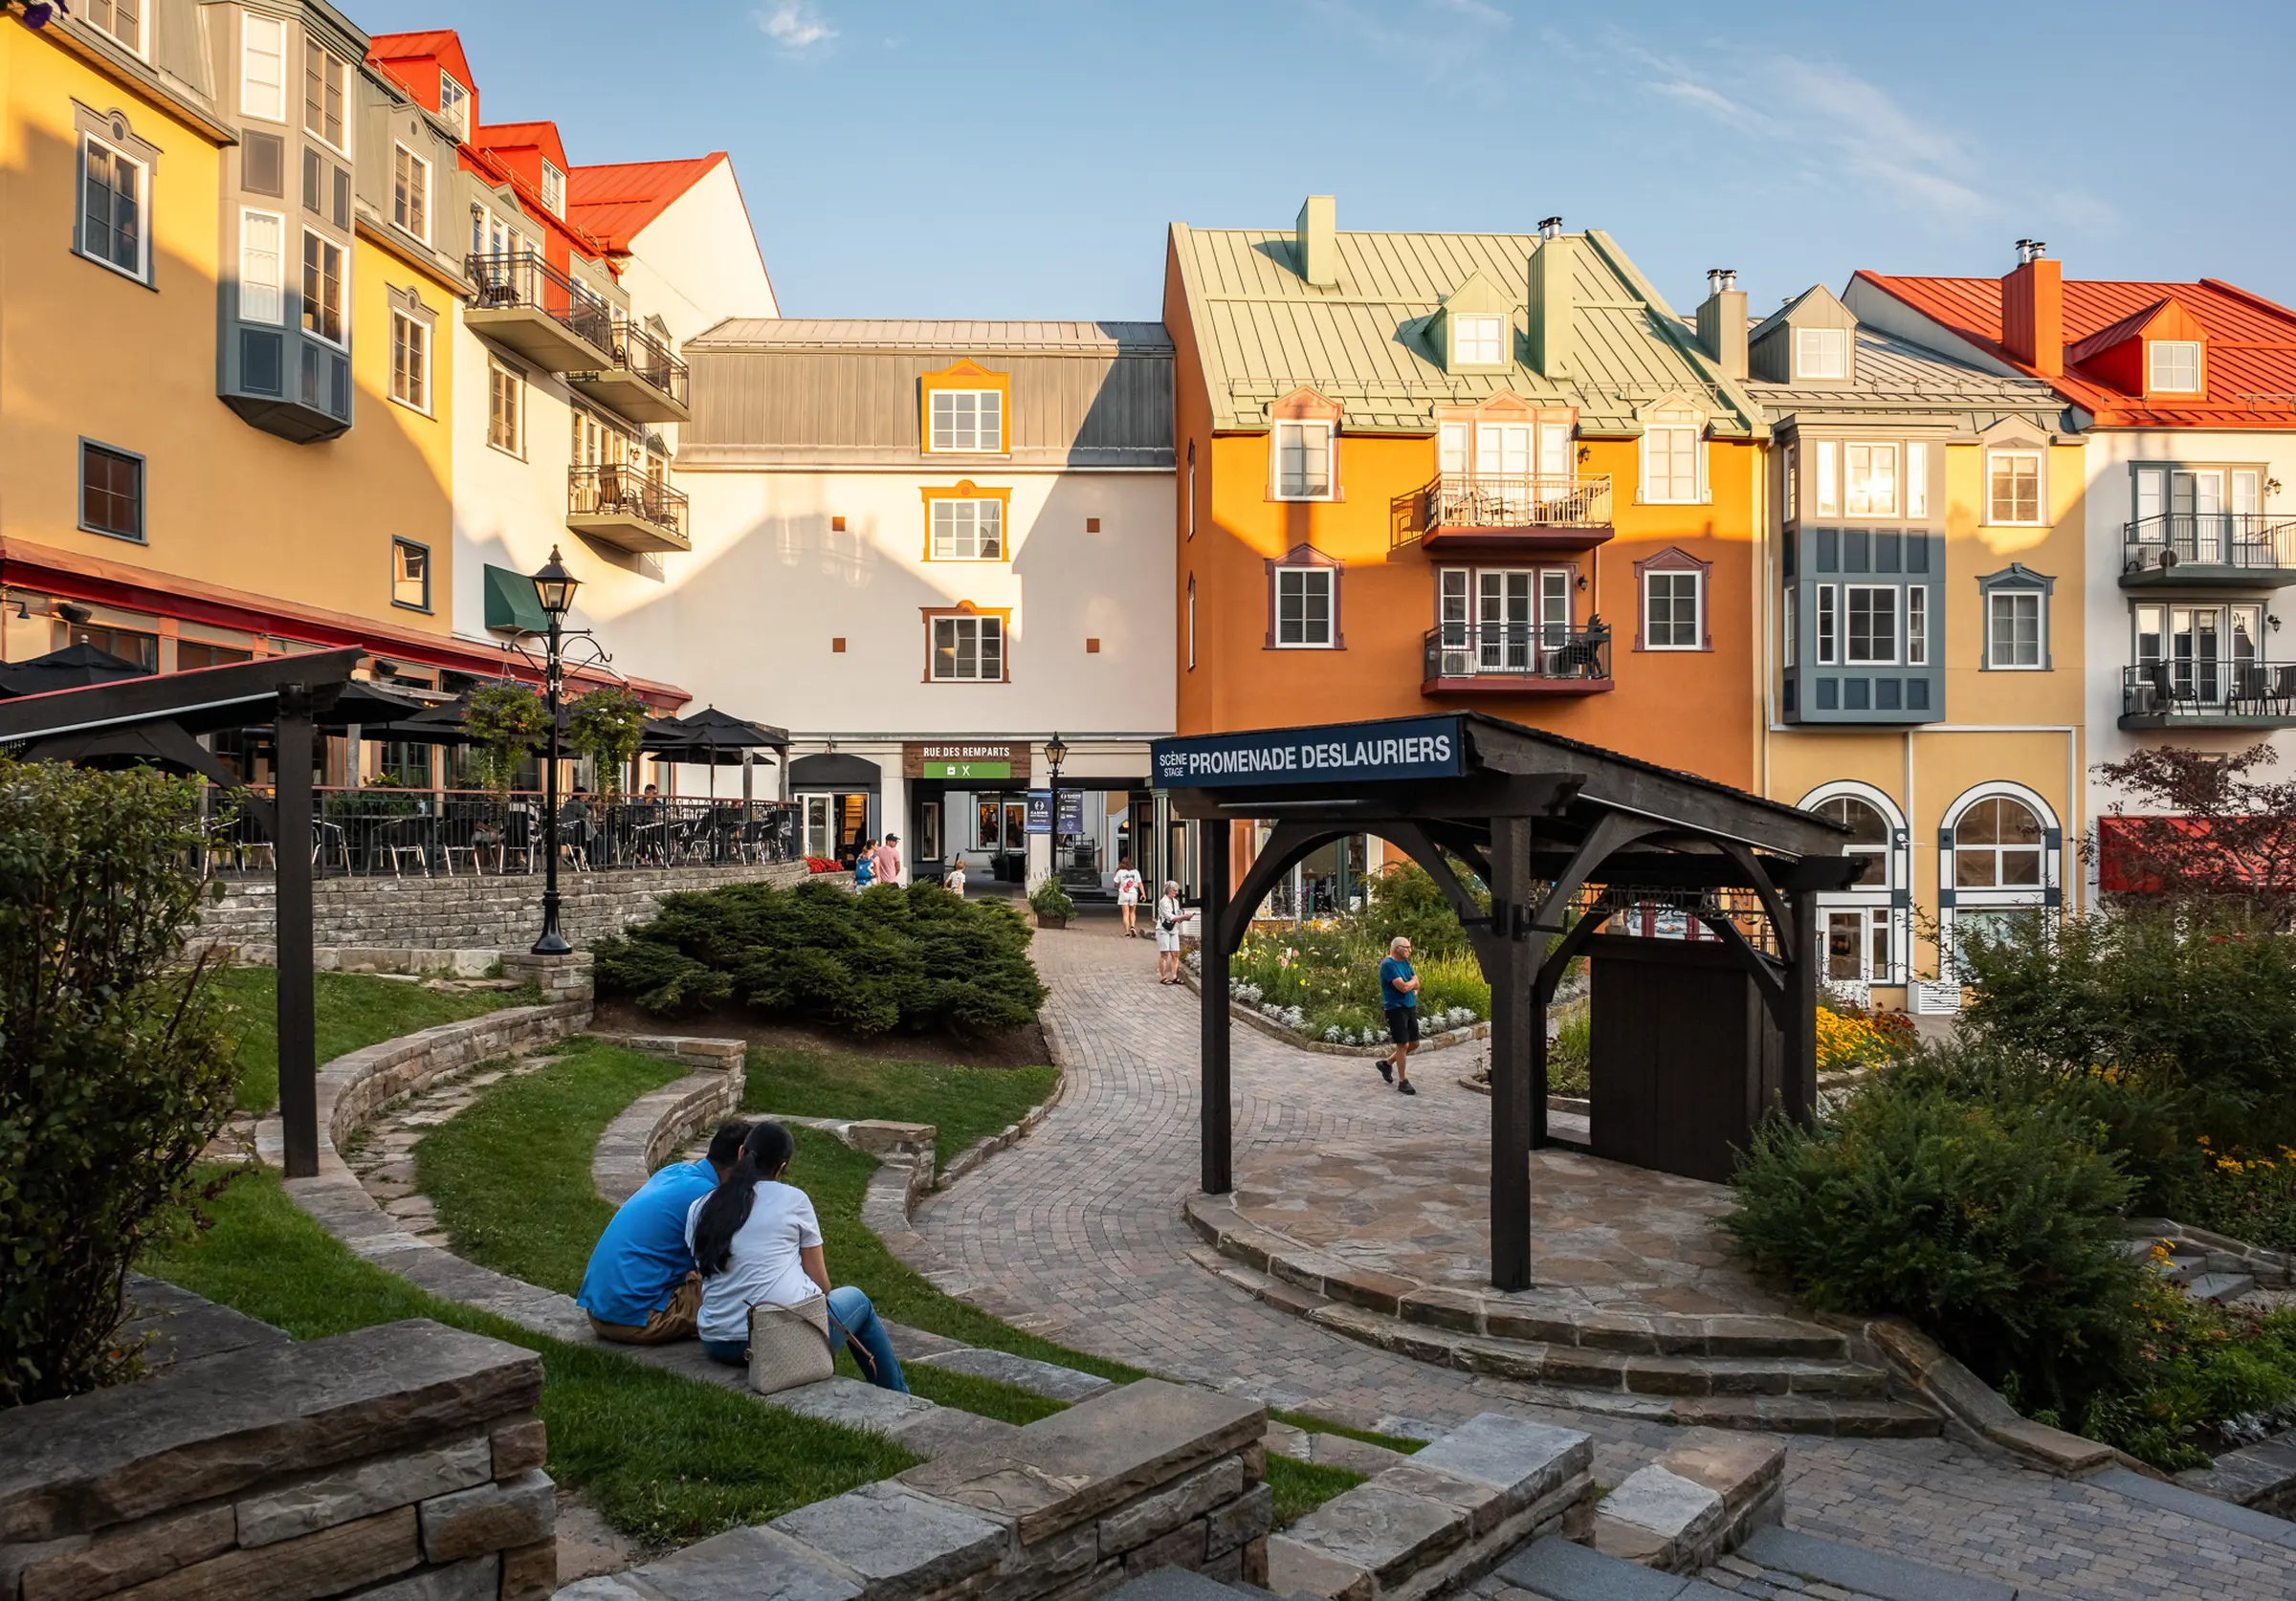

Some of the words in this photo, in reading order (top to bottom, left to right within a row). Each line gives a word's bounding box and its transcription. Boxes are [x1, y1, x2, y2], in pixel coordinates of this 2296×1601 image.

[923, 747, 940, 757] RUE
[943, 747, 960, 757] DES
[962, 747, 1010, 757] REMPARTS
[1159, 751, 1187, 766] SCÈNE
[1189, 746, 1296, 775] PROMENADE
[1301, 735, 1451, 769] DESLAURIERS
[1163, 767, 1184, 778] STAGE
